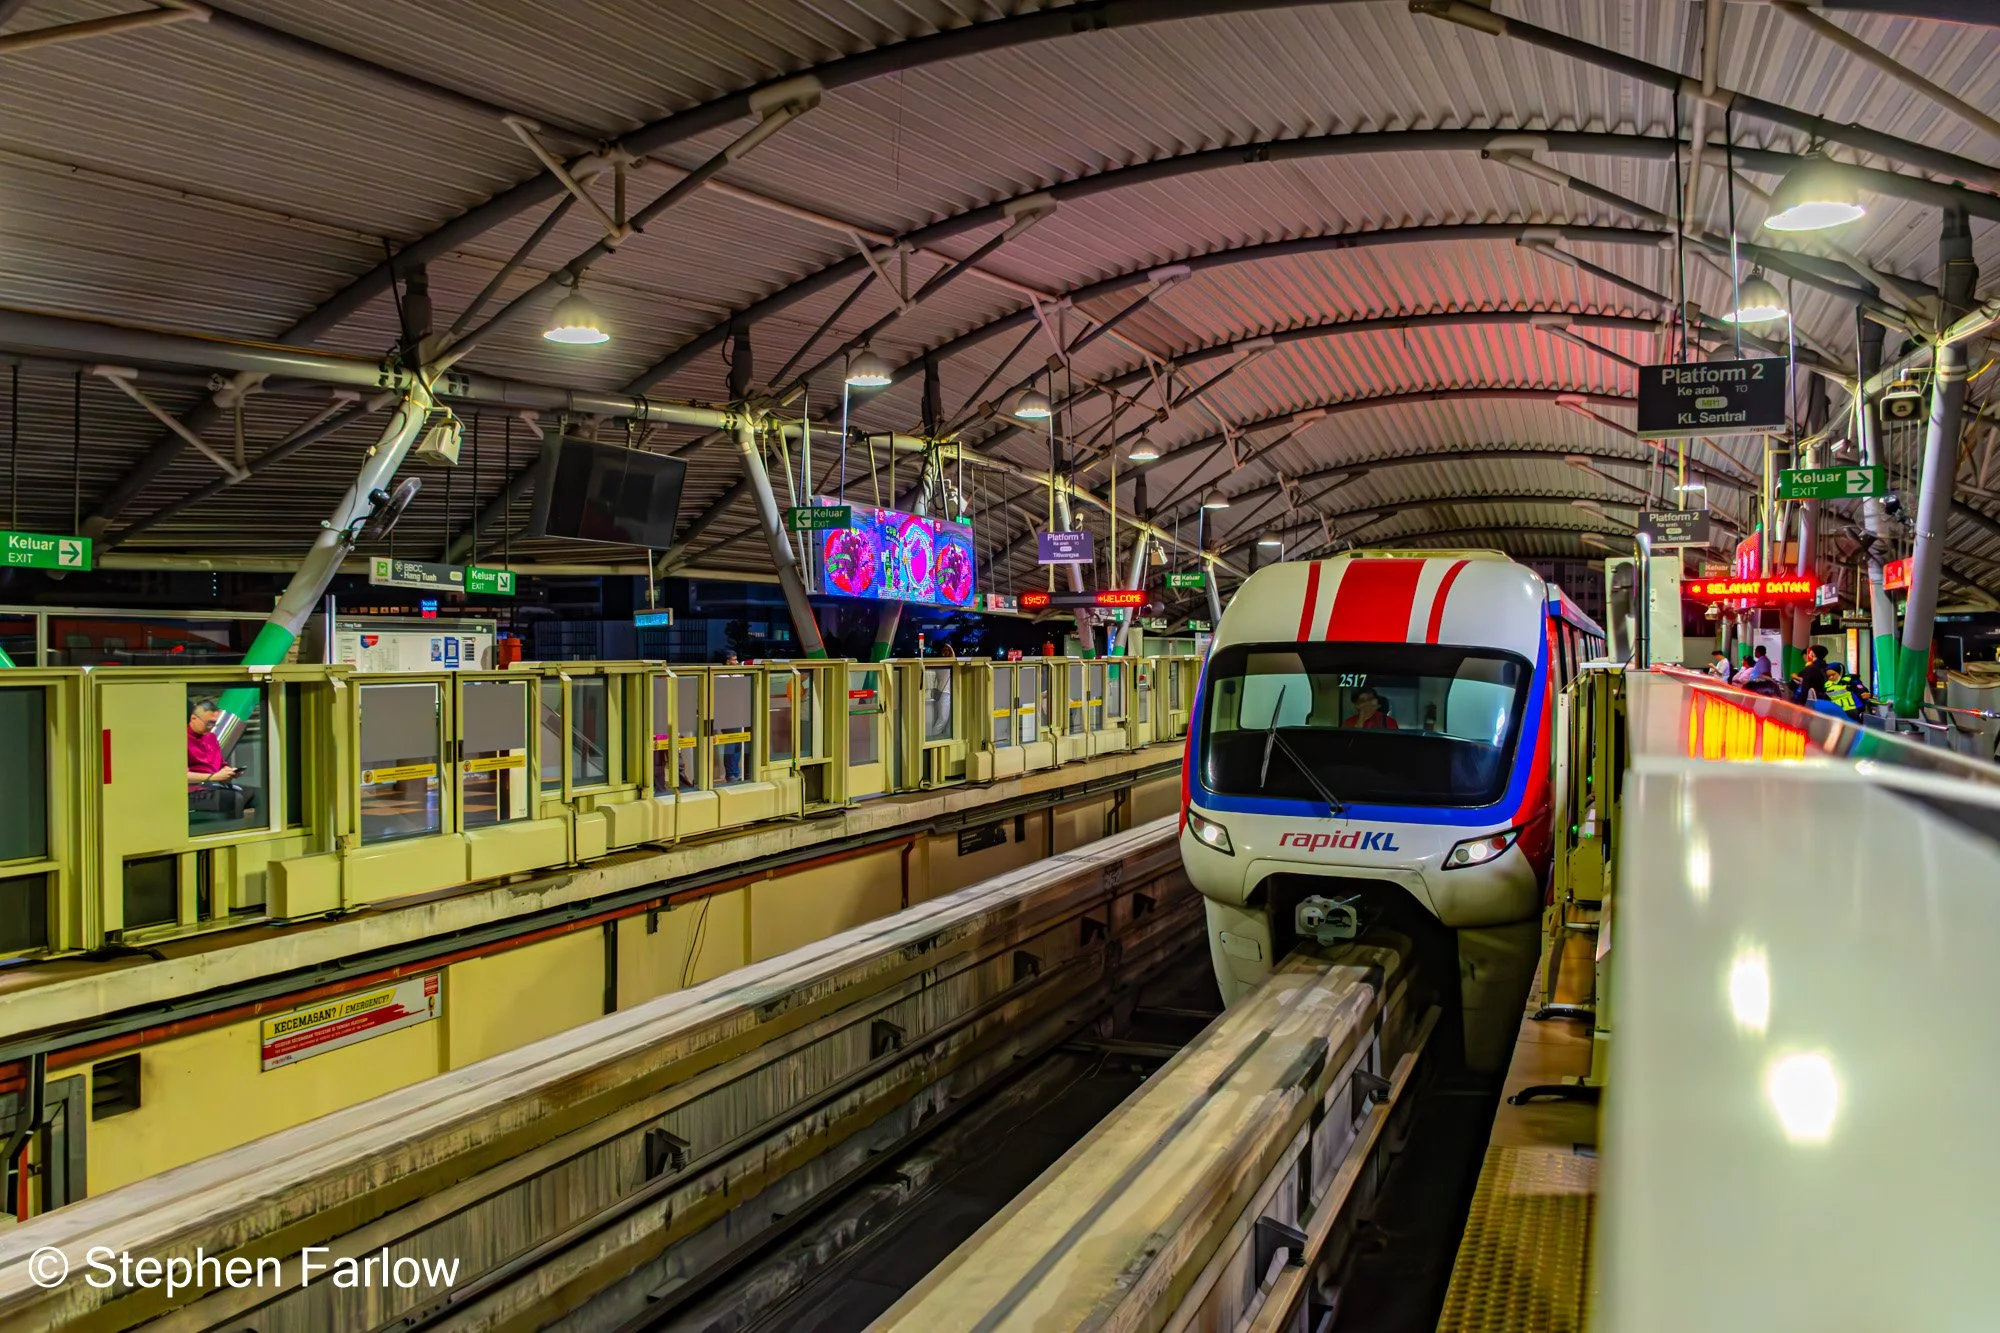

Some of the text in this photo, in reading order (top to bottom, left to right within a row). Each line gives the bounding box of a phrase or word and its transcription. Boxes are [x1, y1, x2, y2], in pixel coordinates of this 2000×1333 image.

[1661, 363, 1764, 385] Platform 2
[1677, 385, 1748, 396] Ke arah TO
[1677, 410, 1746, 424] KL Sentral
[1791, 472, 1841, 484] Keluar
[1791, 487, 1818, 497] EXIT
[813, 508, 844, 518] Keluar
[1649, 511, 1699, 522] Platform 2
[813, 520, 830, 528] EXIT
[1047, 532, 1085, 541] Platform 1
[8, 535, 55, 551] Keluar
[8, 552, 33, 563] EXIT
[403, 571, 437, 582] Hang Tuah
[471, 570, 495, 581] Keluar
[471, 582, 485, 590] EXIT
[1706, 582, 1761, 594] SELAMAT
[1024, 596, 1047, 605] 19:57
[1103, 594, 1141, 603] WELCOME
[1338, 673, 1367, 687] 2517
[1279, 830, 1400, 852] rapidKL
[274, 1007, 337, 1034] KECEMASAN?
[345, 994, 390, 1014] EMERGENCY?
